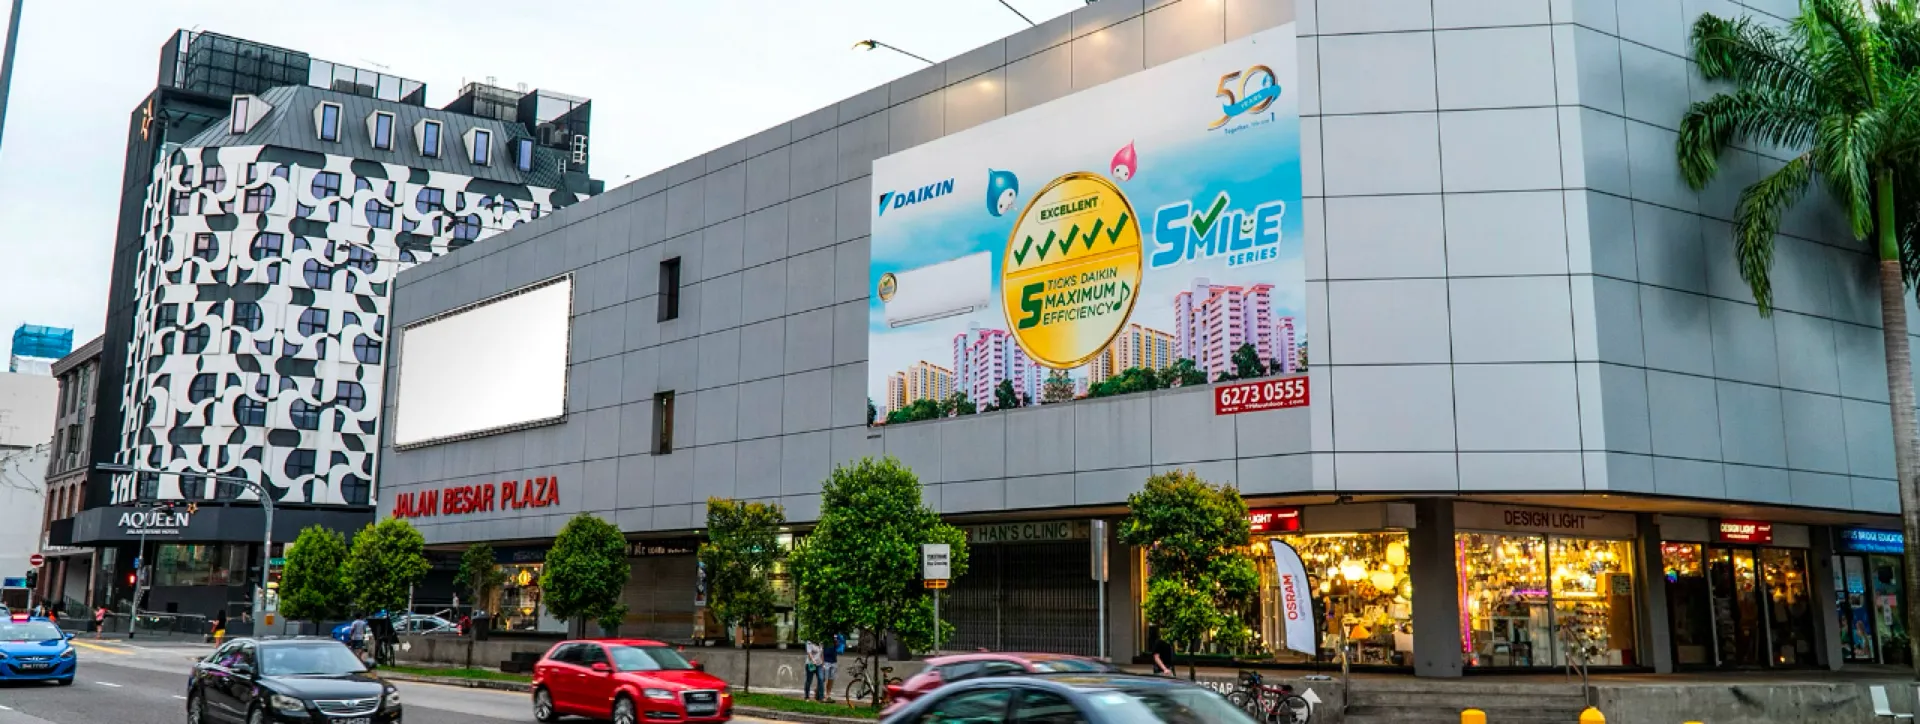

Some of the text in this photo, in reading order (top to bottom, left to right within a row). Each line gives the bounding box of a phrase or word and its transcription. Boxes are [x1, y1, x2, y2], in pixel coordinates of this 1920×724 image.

[893, 178, 954, 209] DAIKIN
[1040, 196, 1098, 221] EXCELLENT
[1151, 194, 1283, 268] SMILE
[1228, 246, 1277, 267] SERIES
[1018, 266, 1118, 329] 5 TICKS DAIKIN
[1044, 281, 1116, 309] MAXIMUM
[1042, 301, 1114, 326] EFFICIENCY
[1221, 380, 1305, 406] 6273 0555
[392, 475, 560, 519] JALAN BESAR PLAZA
[118, 512, 190, 528] AQUEEN
[978, 522, 1068, 542] HAN'S CLINIC
[1503, 509, 1586, 530] DESIGN LIGHT
[1282, 573, 1299, 621] OSRAM
